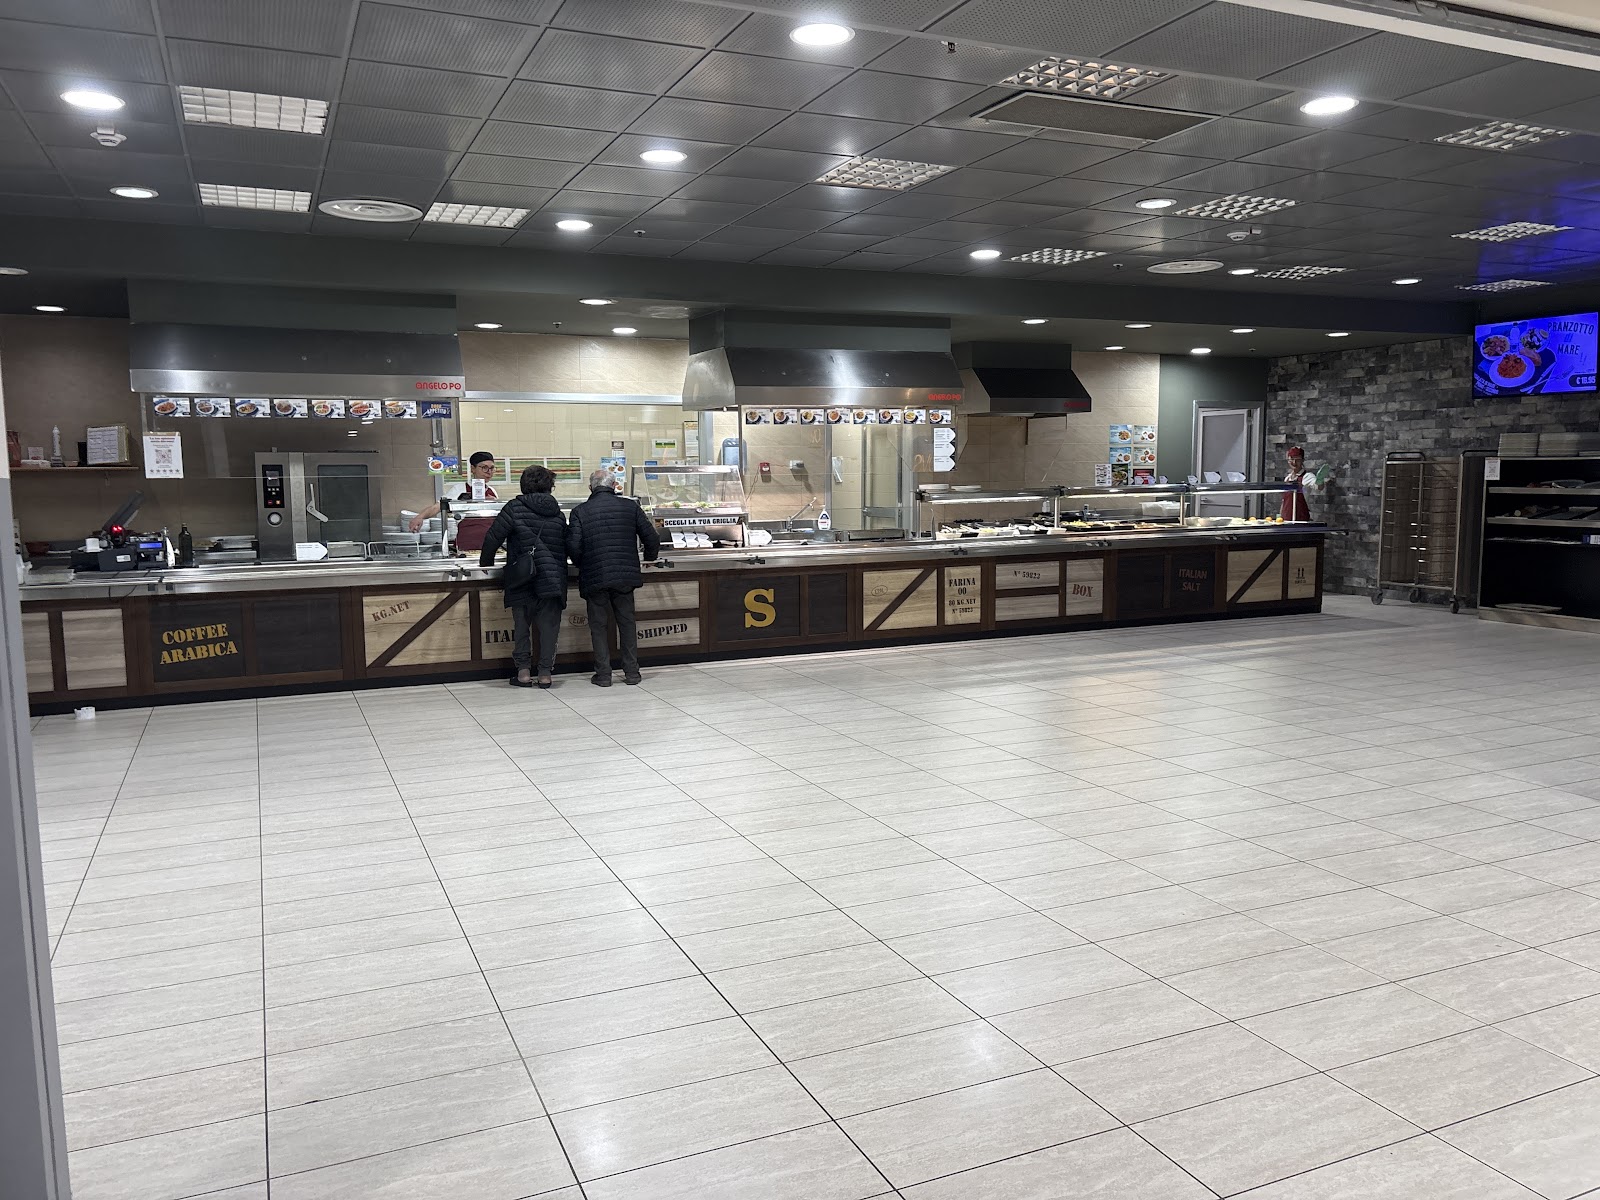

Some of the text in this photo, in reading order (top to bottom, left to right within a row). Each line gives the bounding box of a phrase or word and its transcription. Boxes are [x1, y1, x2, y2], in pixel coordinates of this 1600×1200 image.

[1547, 321, 1595, 335] PRANZOTTO
[1557, 344, 1580, 356] MARE
[416, 382, 462, 390] ANGELO PO
[712, 517, 737, 525] GRIGLIA
[1179, 568, 1208, 579] ITALIAN
[949, 577, 976, 587] FARINA
[1182, 582, 1201, 591] SALT
[1072, 583, 1094, 598] BOX
[371, 600, 410, 622] KG.NET
[744, 588, 777, 629] S
[162, 623, 229, 645] COFFEE
[636, 622, 688, 640] SHIPPED
[160, 640, 238, 665] ARABICA
